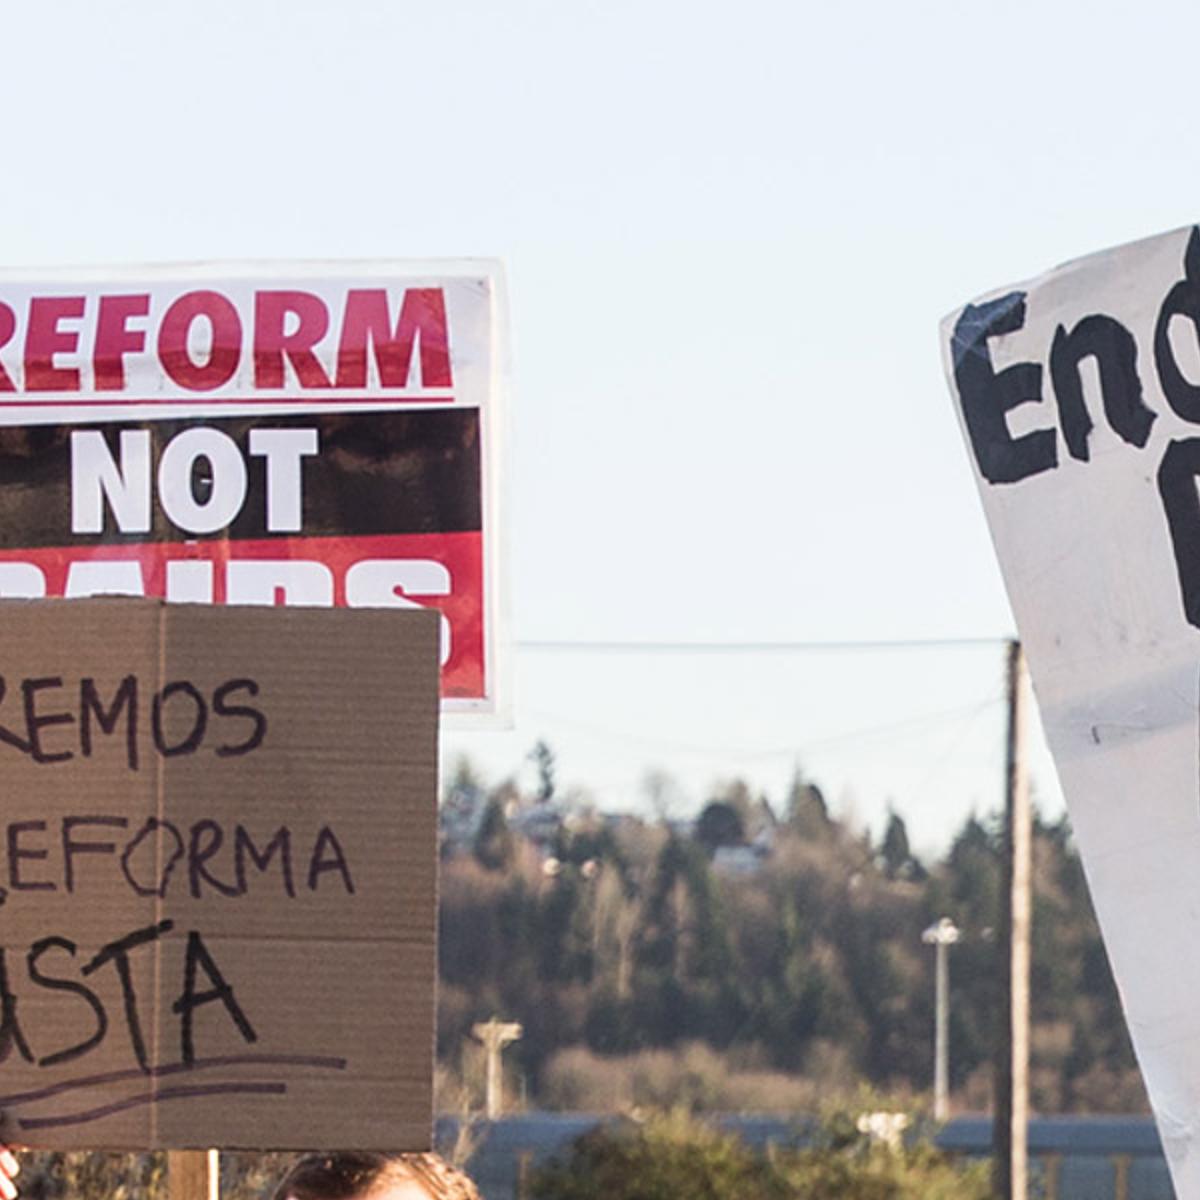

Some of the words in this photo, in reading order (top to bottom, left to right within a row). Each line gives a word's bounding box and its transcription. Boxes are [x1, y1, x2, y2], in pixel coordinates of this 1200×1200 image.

[0, 288, 454, 393] EFORM
[71, 427, 319, 534] NOT
[0, 816, 355, 899] EFORMA
